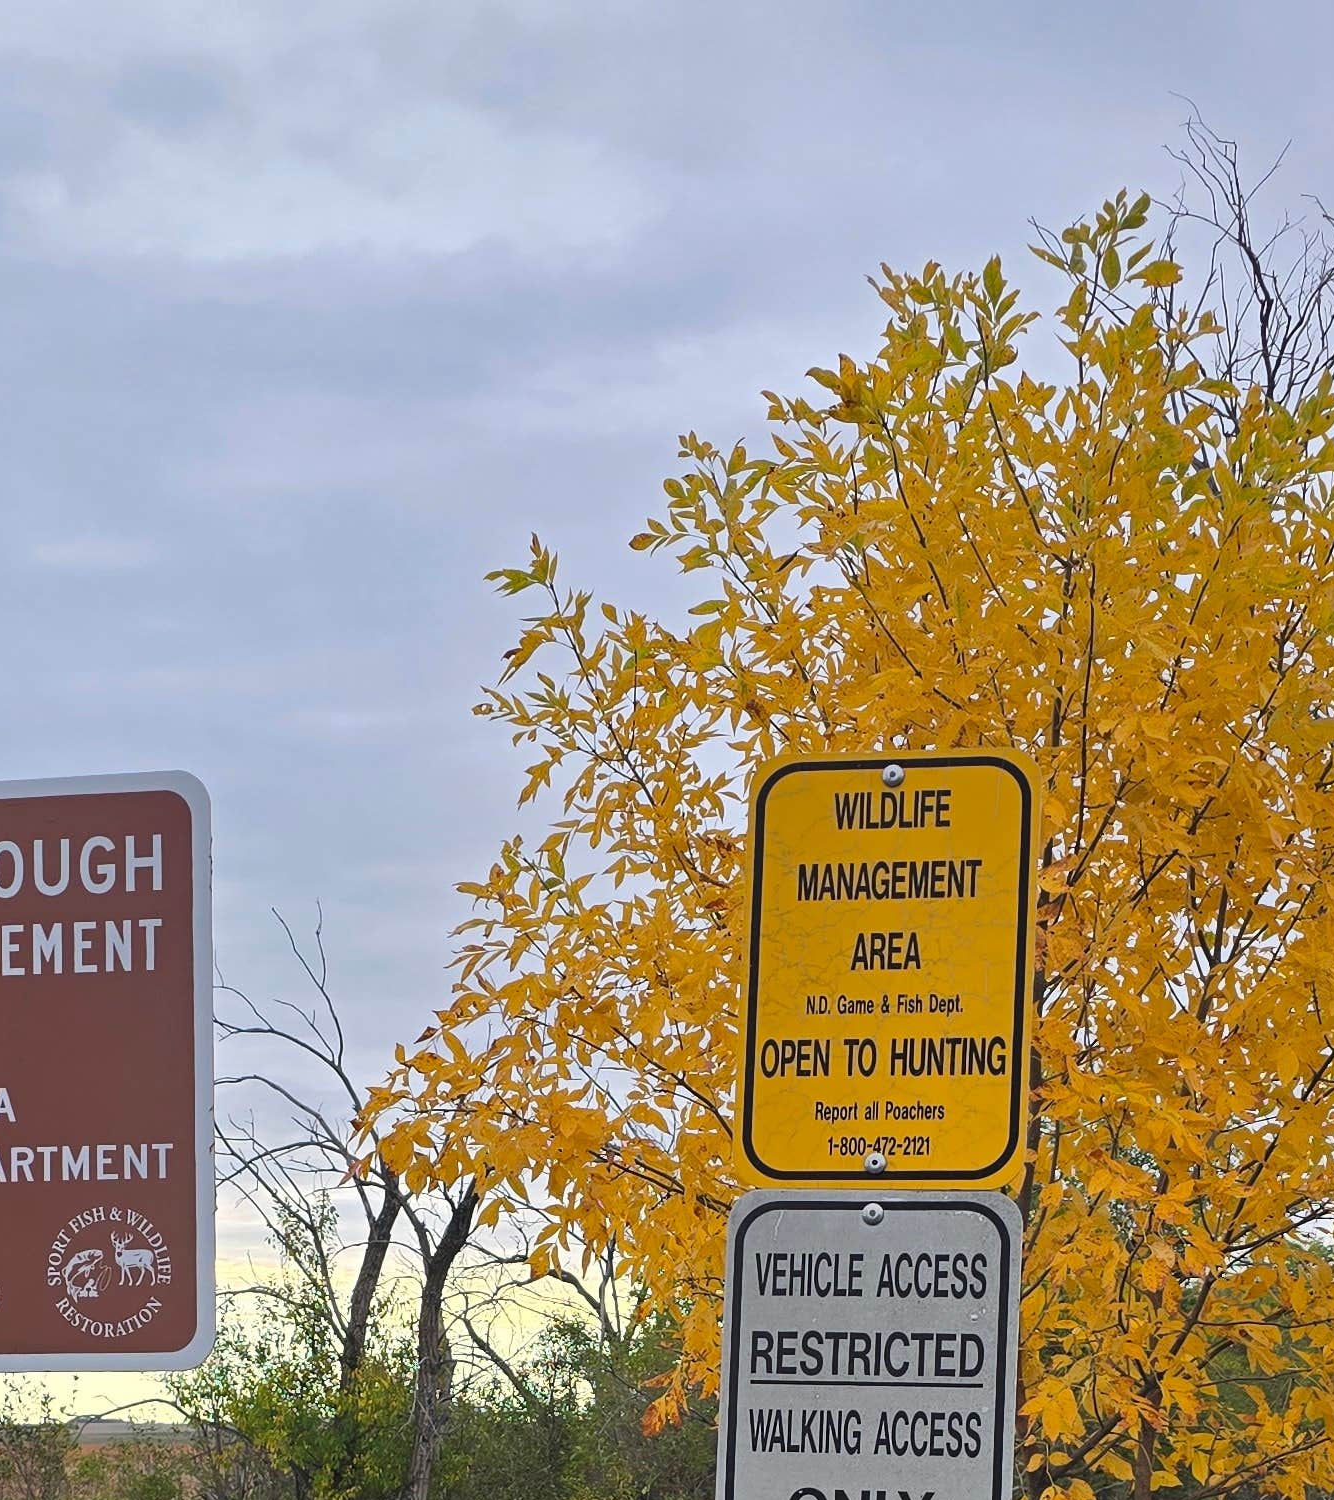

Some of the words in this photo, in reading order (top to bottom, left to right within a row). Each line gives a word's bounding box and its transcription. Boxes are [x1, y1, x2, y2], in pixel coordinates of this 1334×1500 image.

[835, 790, 951, 830] WILDLIFE
[798, 860, 982, 901] MANAGEMENT
[851, 932, 921, 971] AREA
[806, 996, 831, 1015] N.D.
[837, 995, 874, 1015] Game
[881, 996, 890, 1014] &
[897, 994, 923, 1014] Fish
[929, 994, 963, 1016] Dept.
[761, 1039, 830, 1078] OPEN
[843, 1039, 877, 1076] TO
[890, 1036, 1006, 1076] HUNTING
[815, 1102, 858, 1124] Report
[865, 1101, 879, 1120] all
[885, 1101, 945, 1120] Poachers
[828, 1136, 930, 1156] 1-800-472-2121
[48, 1229, 71, 1286] SPORT
[68, 1207, 105, 1234] FISH
[110, 1207, 122, 1221] &
[127, 1209, 171, 1285] WILDLIFE
[756, 1252, 864, 1298] VEHICLE
[877, 1253, 987, 1299] ACCESS
[56, 1296, 162, 1338] RESTORATION
[751, 1330, 984, 1378] RESTRICTED
[749, 1409, 862, 1455] WALKING
[873, 1411, 981, 1458] ACCESS
